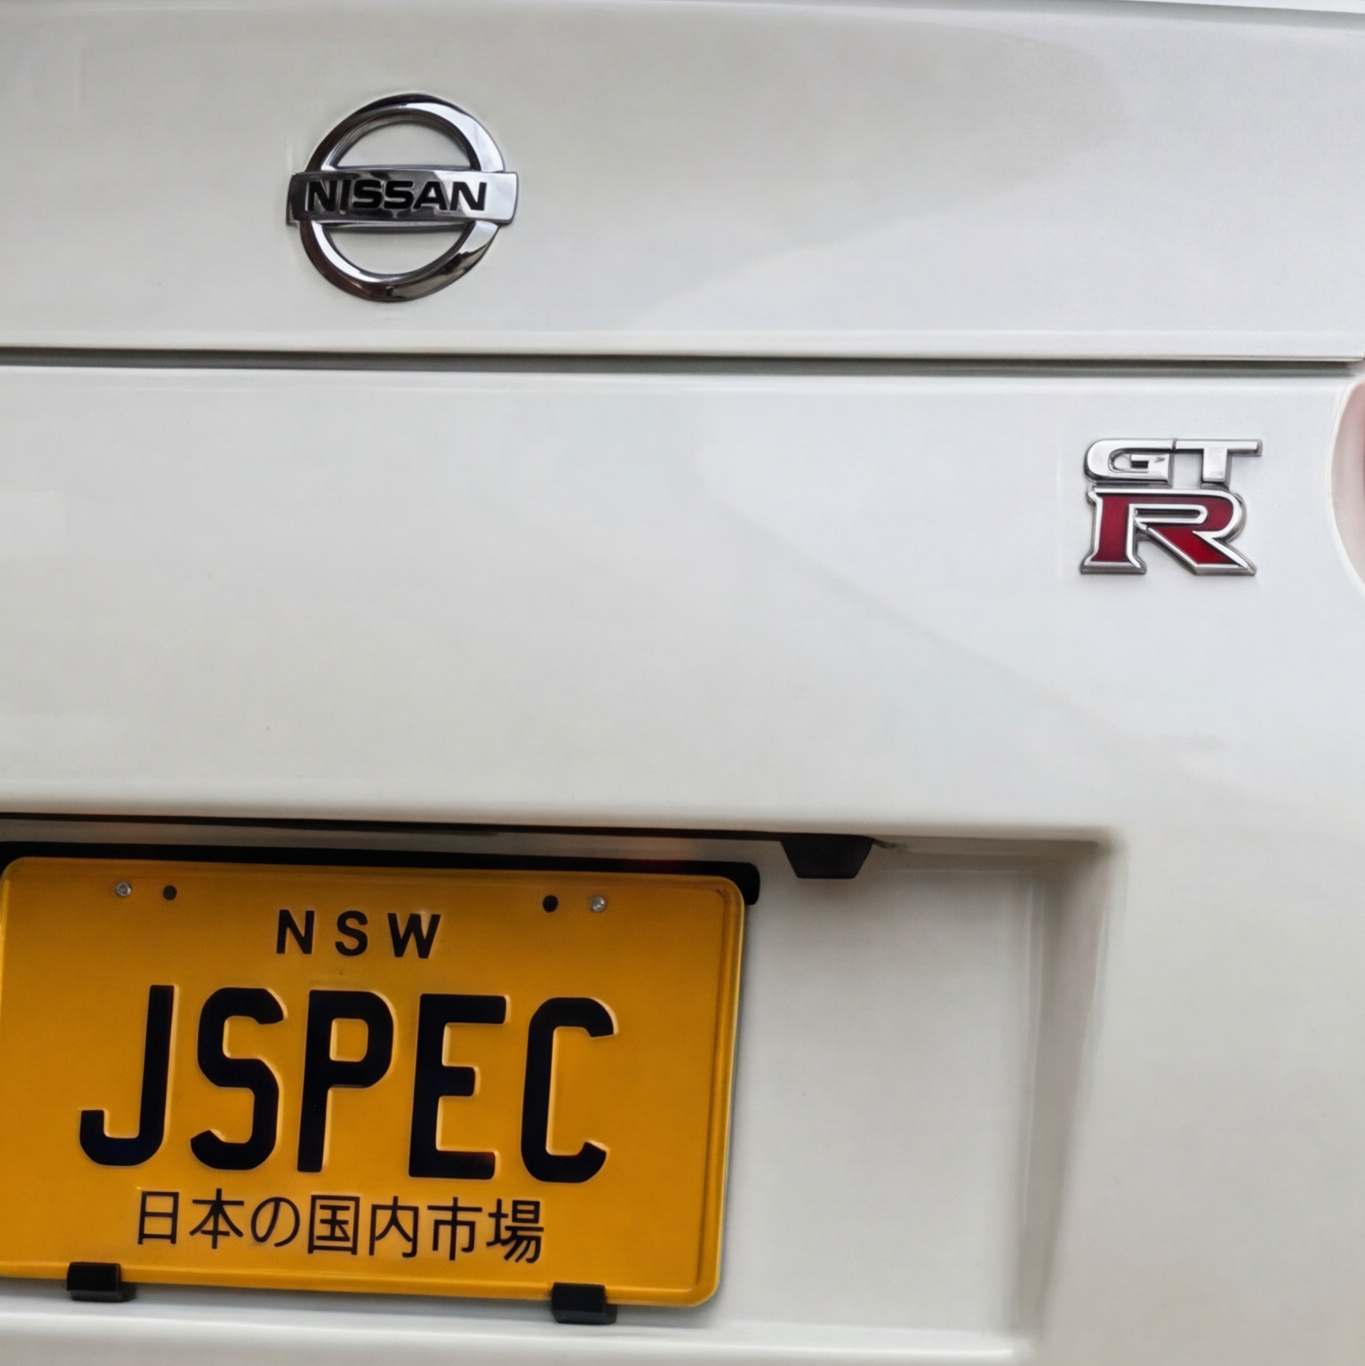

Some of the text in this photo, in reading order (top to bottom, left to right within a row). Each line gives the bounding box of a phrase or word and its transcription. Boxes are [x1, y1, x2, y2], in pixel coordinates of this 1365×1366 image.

[307, 179, 487, 212] NISSAN
[1084, 438, 1262, 485] GT
[1079, 487, 1257, 576] R
[79, 985, 616, 1184] JSPEC
[137, 1188, 545, 1265] 日本の国内市場
